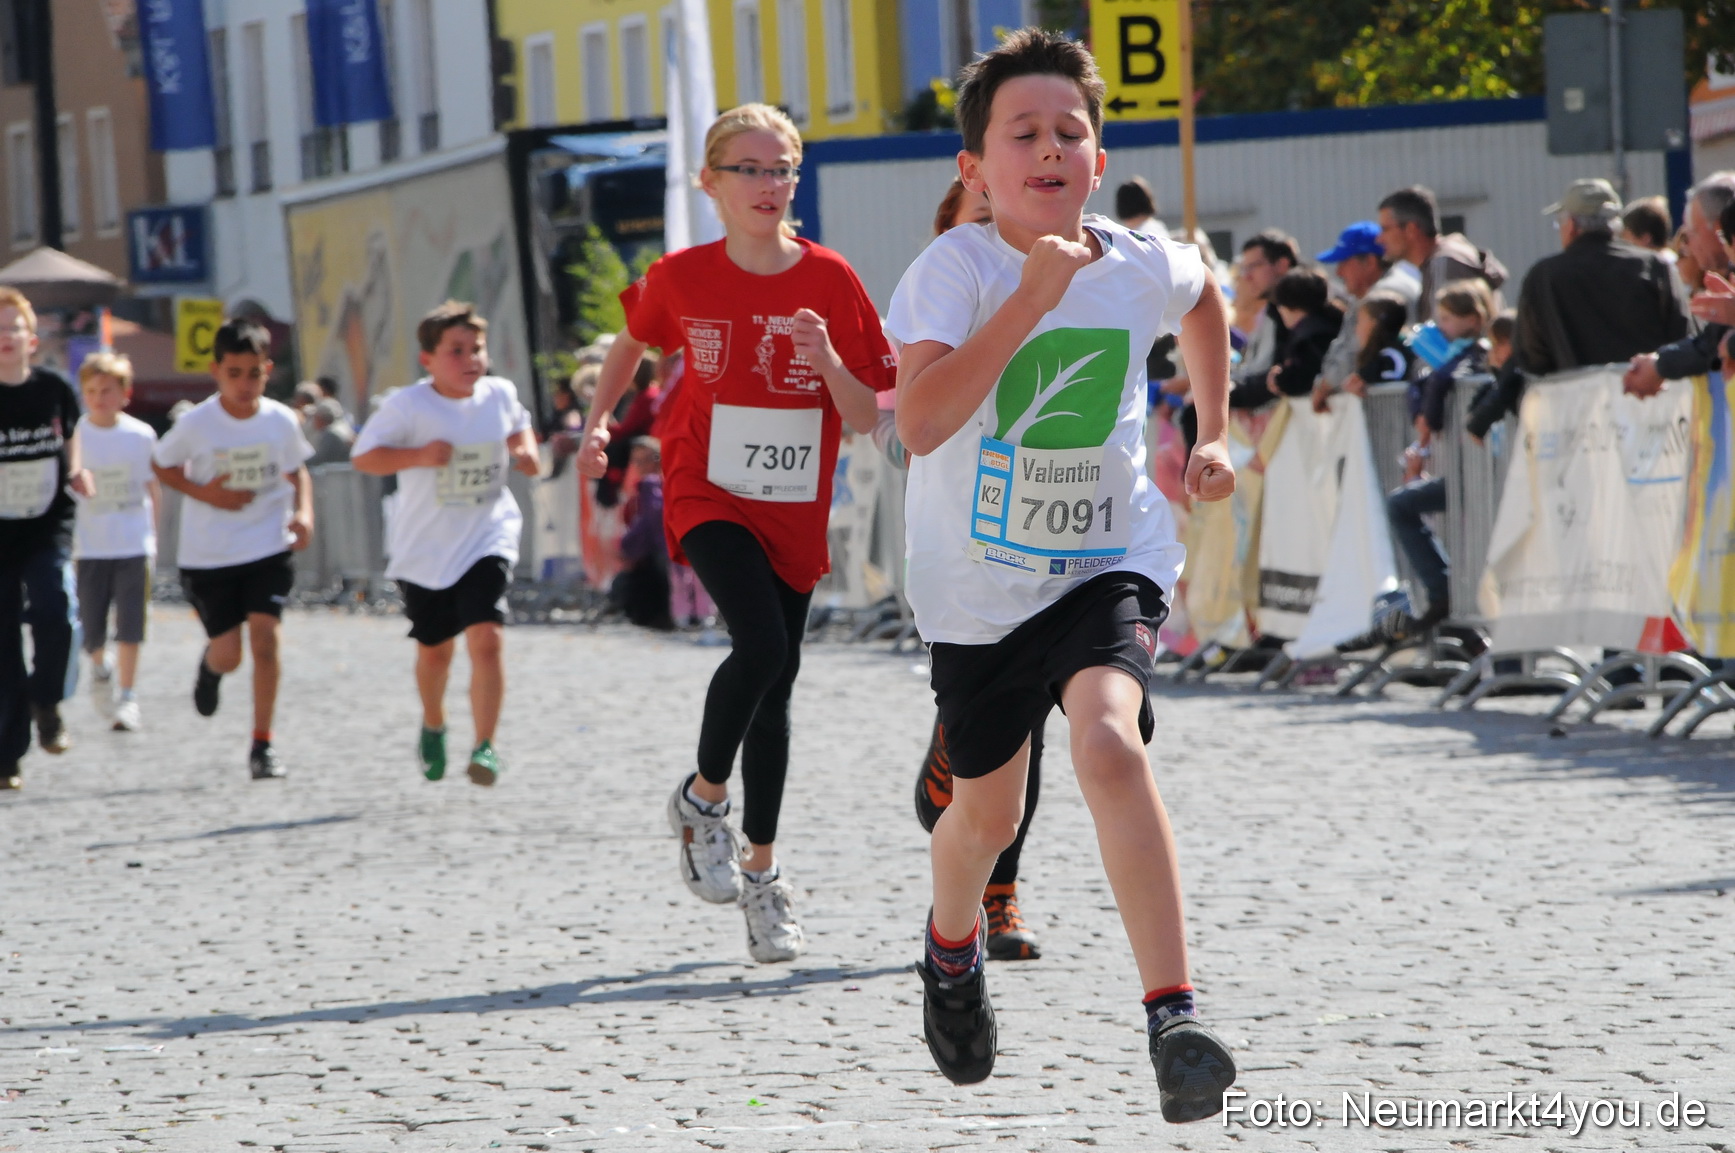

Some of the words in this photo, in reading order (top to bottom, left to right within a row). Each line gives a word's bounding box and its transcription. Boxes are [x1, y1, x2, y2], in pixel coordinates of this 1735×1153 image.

[1118, 15, 1165, 85] B
[189, 320, 213, 356] C
[744, 444, 812, 471] 7307
[1023, 457, 1101, 484] Valentin
[981, 484, 1001, 505] K2
[1020, 496, 1113, 535] 7091
[985, 547, 1026, 566] BOCK
[1067, 556, 1124, 569] PFLEIDERER
